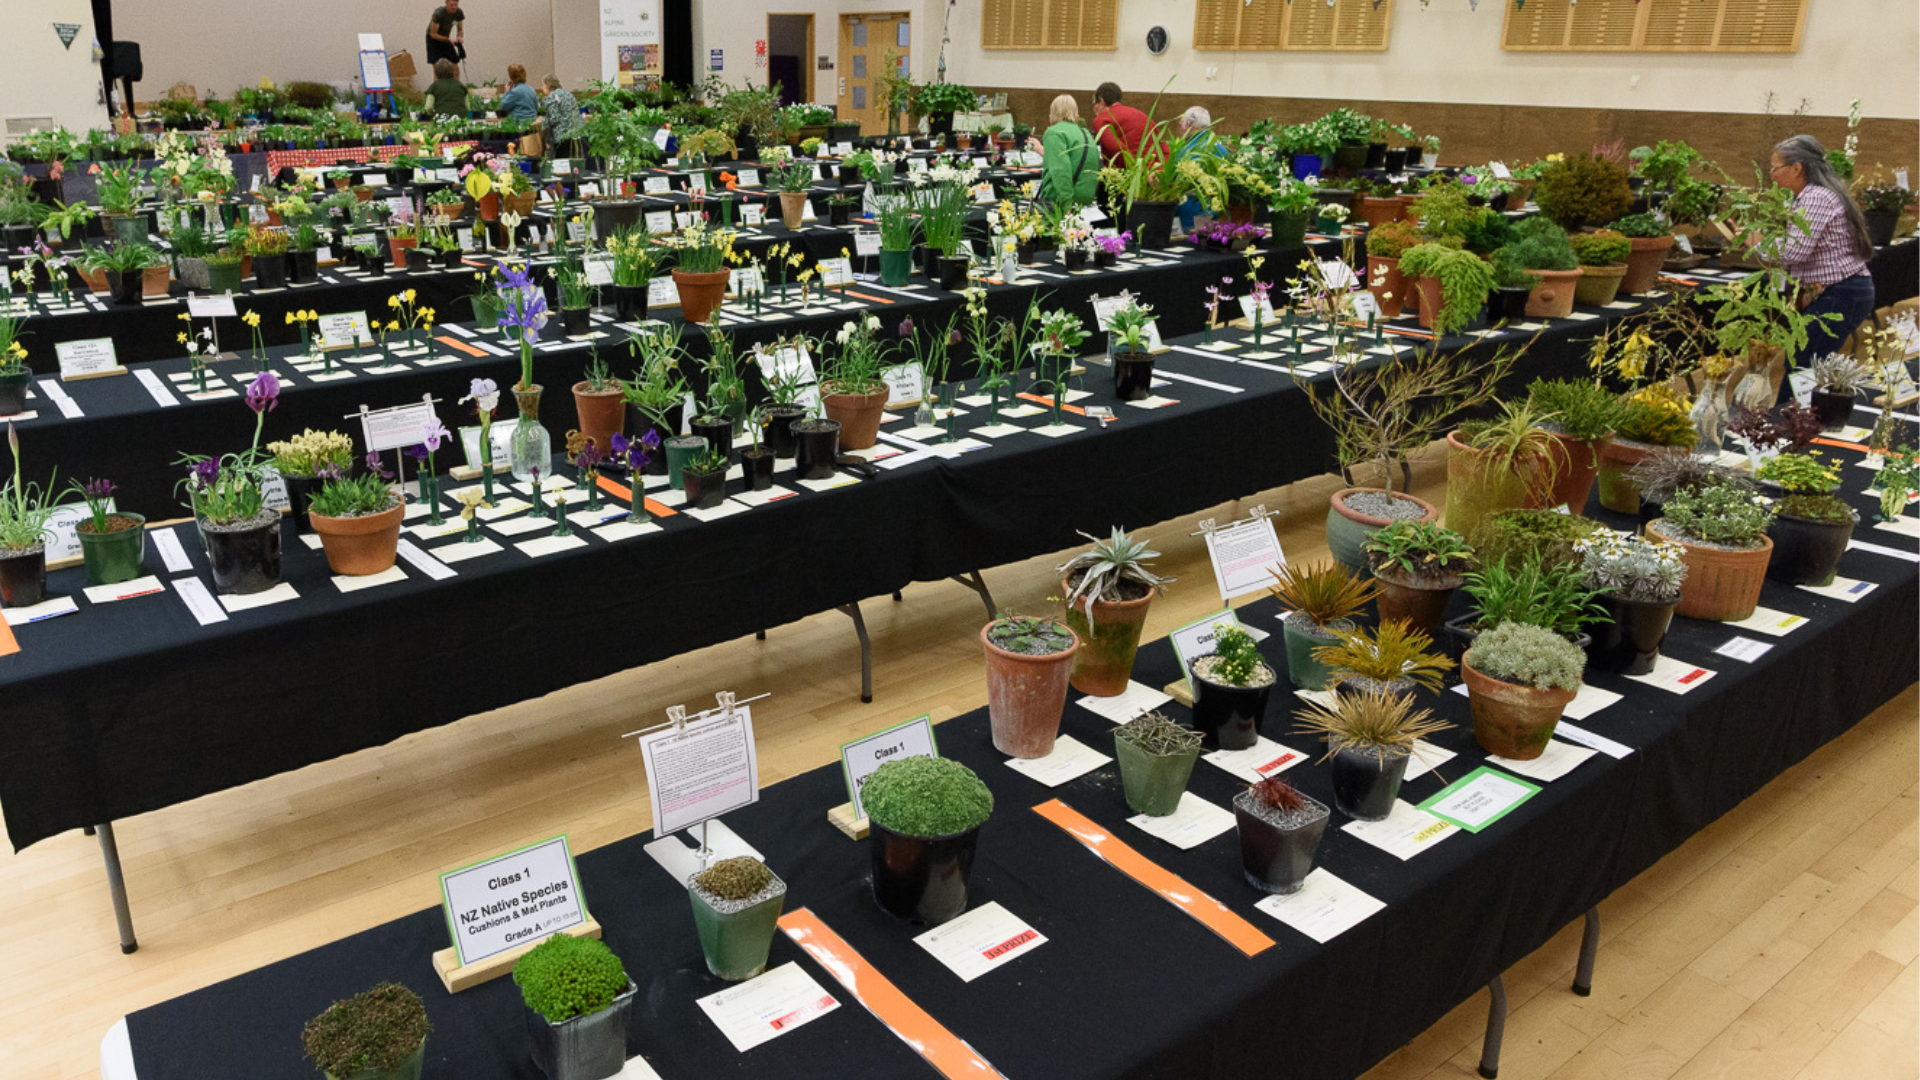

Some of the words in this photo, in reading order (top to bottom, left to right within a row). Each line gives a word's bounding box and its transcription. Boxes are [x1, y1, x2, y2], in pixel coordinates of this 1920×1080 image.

[875, 746, 898, 760] Class
[899, 741, 905, 751] 1
[488, 871, 522, 890] Class
[524, 867, 531, 878] 1
[460, 909, 479, 925] NZ
[481, 895, 519, 918] Native
[521, 880, 568, 904] Species
[468, 914, 511, 936] Cushions
[512, 911, 521, 920] &
[521, 903, 539, 916] Mat
[540, 894, 567, 911] Plants
[504, 925, 533, 943] Grade
[535, 922, 542, 932] A
[987, 947, 1003, 959] 1st
[1002, 932, 1032, 951] PRIZE
